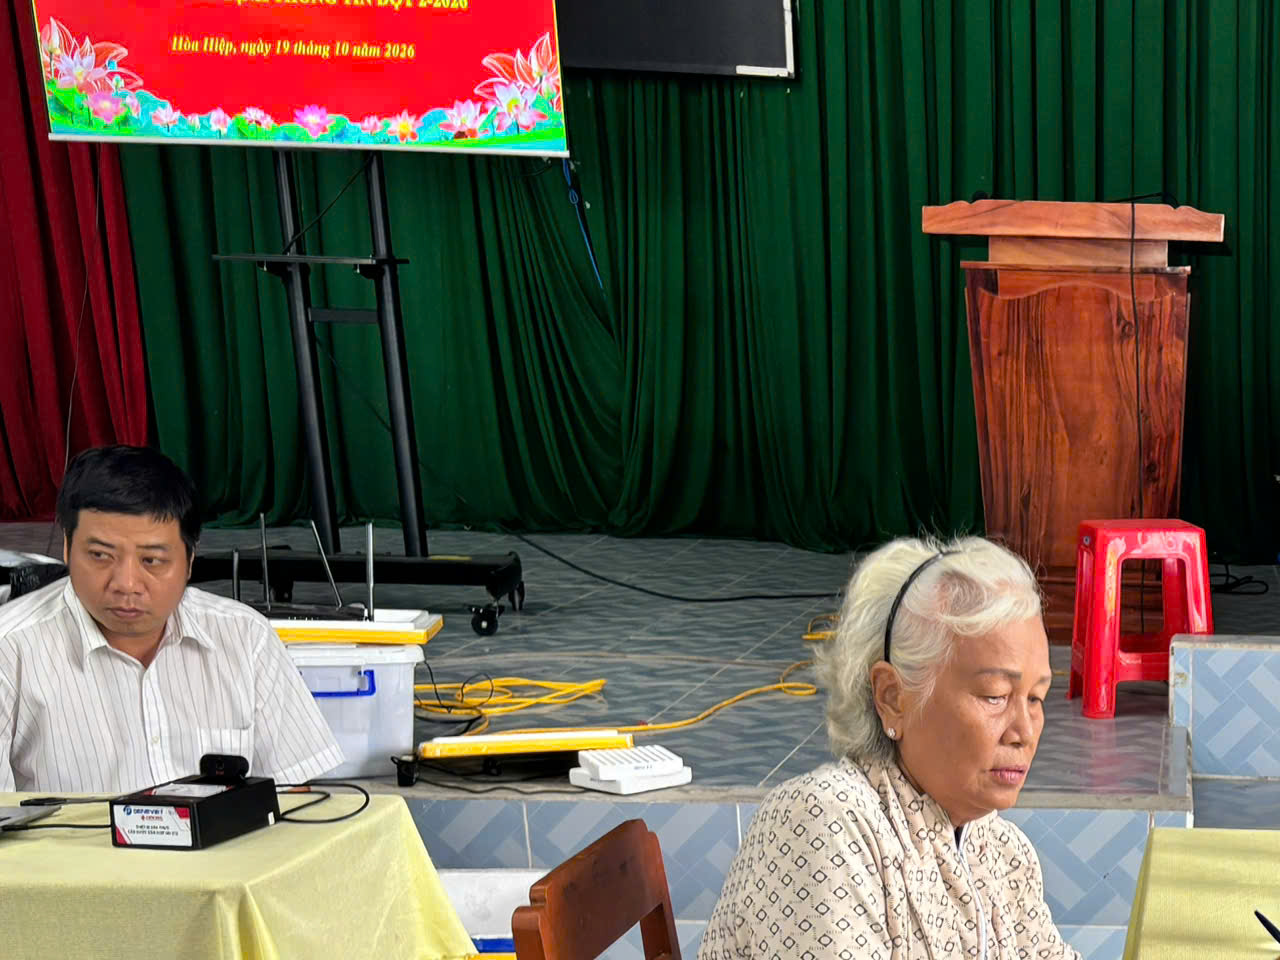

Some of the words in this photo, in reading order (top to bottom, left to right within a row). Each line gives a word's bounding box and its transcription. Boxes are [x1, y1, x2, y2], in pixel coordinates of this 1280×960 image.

[171, 36, 199, 52] Hòa
[203, 36, 237, 55] Hiệp,
[241, 38, 271, 57] ngày
[276, 40, 290, 54] 19
[294, 39, 330, 59] tháng
[335, 41, 349, 56] 10
[352, 41, 381, 57] năm
[384, 42, 416, 59] 2026
